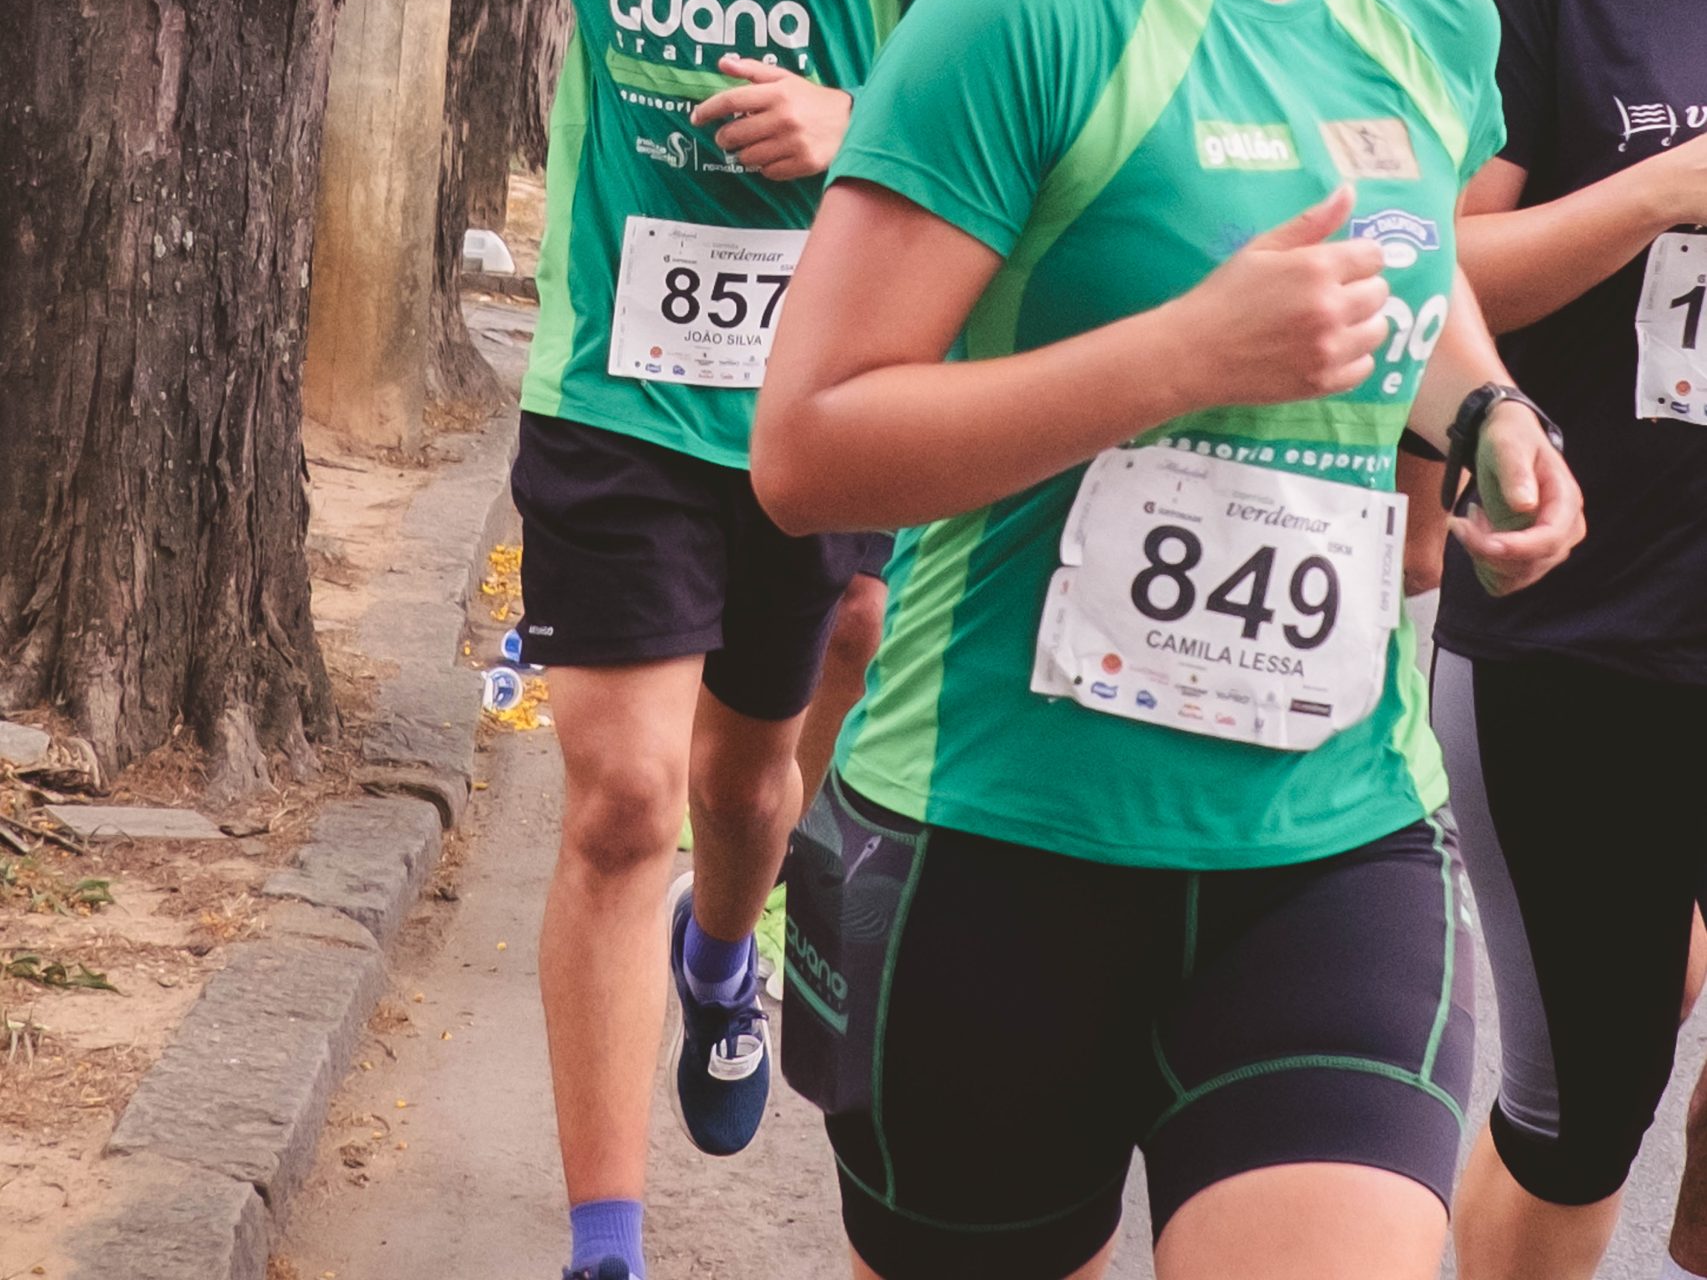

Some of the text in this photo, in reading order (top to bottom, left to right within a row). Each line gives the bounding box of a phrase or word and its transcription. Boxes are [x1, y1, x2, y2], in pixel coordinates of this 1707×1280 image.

[710, 247, 784, 263] verdemar
[661, 267, 792, 329] 857
[727, 334, 762, 346] SILVA
[1225, 500, 1332, 535] verdemar
[1130, 523, 1342, 650] 849
[1146, 629, 1305, 678] CAMILA LESSA
